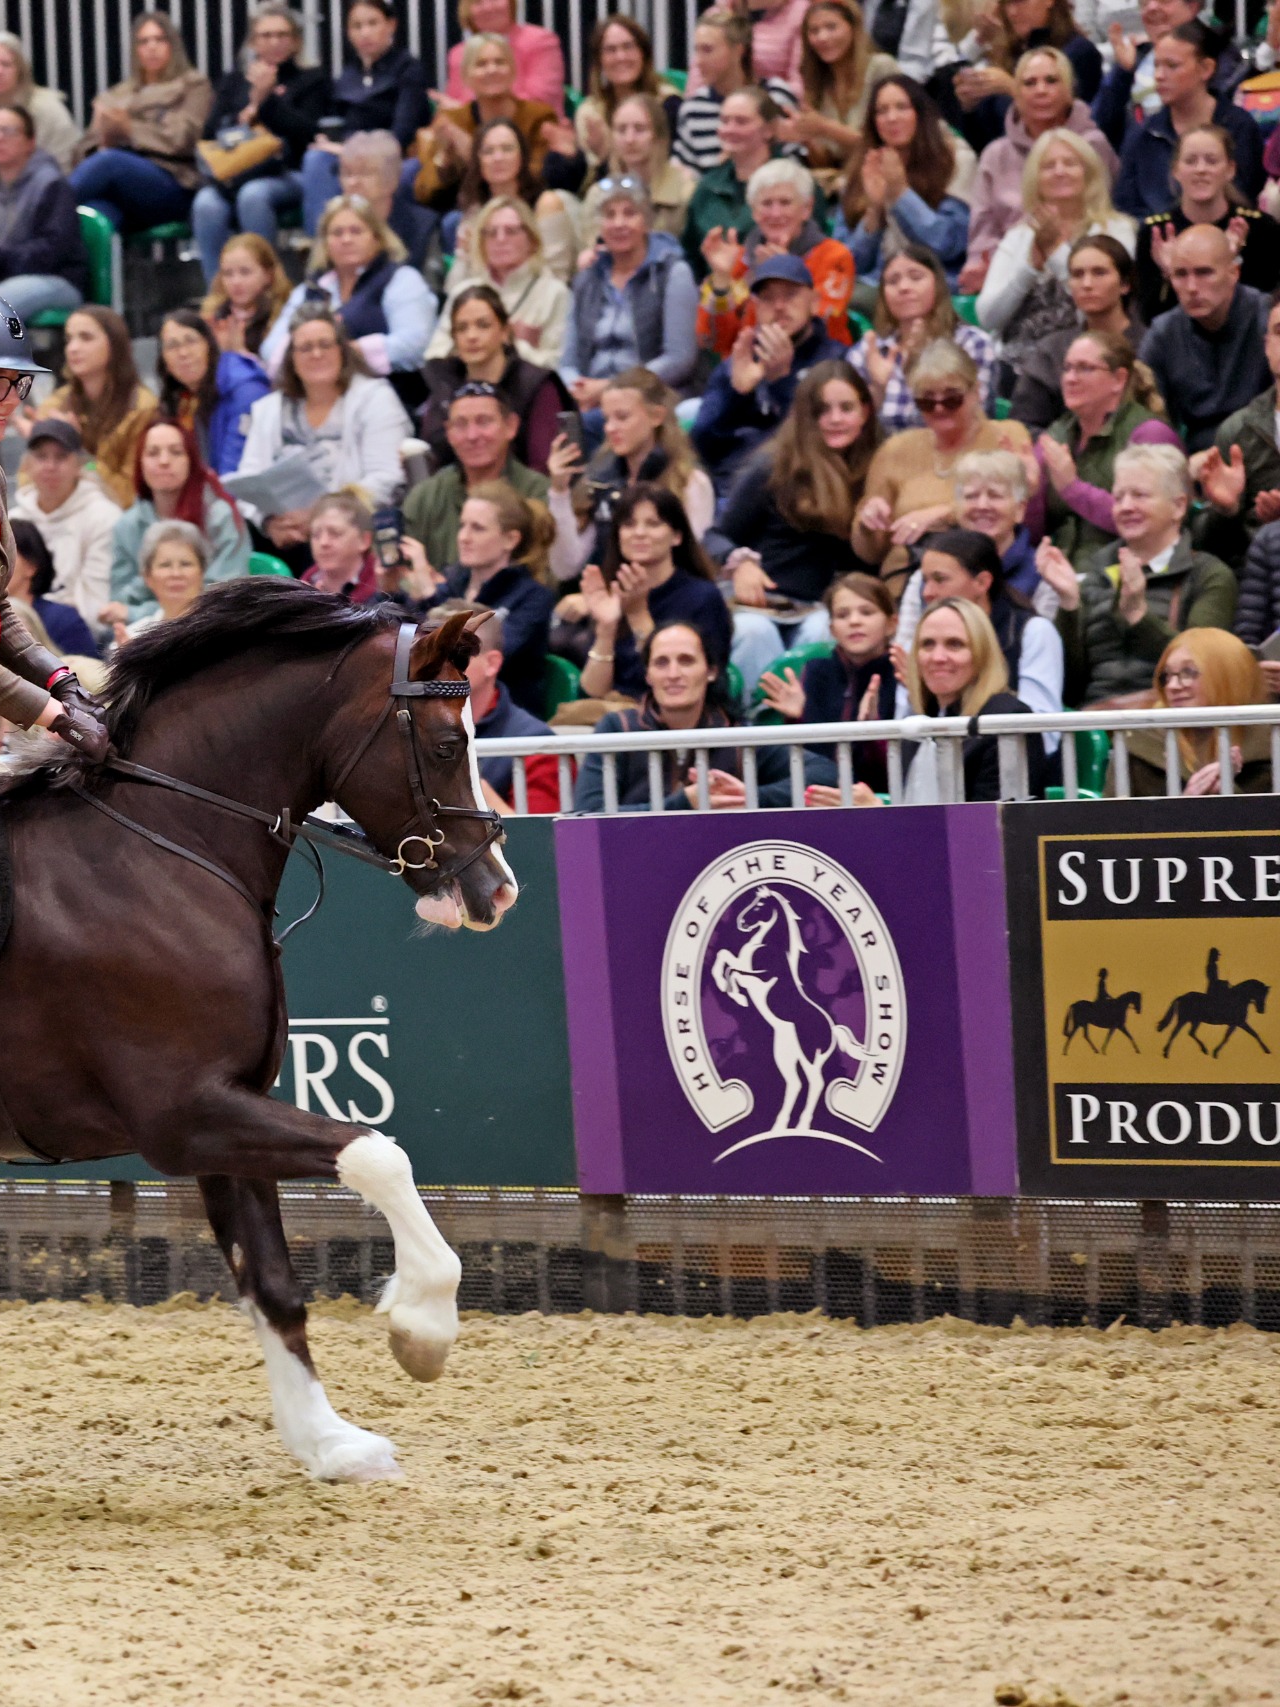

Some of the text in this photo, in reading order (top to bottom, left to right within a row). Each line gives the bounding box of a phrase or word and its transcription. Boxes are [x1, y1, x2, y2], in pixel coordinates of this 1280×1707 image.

[1057, 851, 1280, 906] SUPRE
[674, 854, 893, 1092] HORSE OF THE YEAR SHOW
[1065, 1093, 1280, 1146] PRODU
